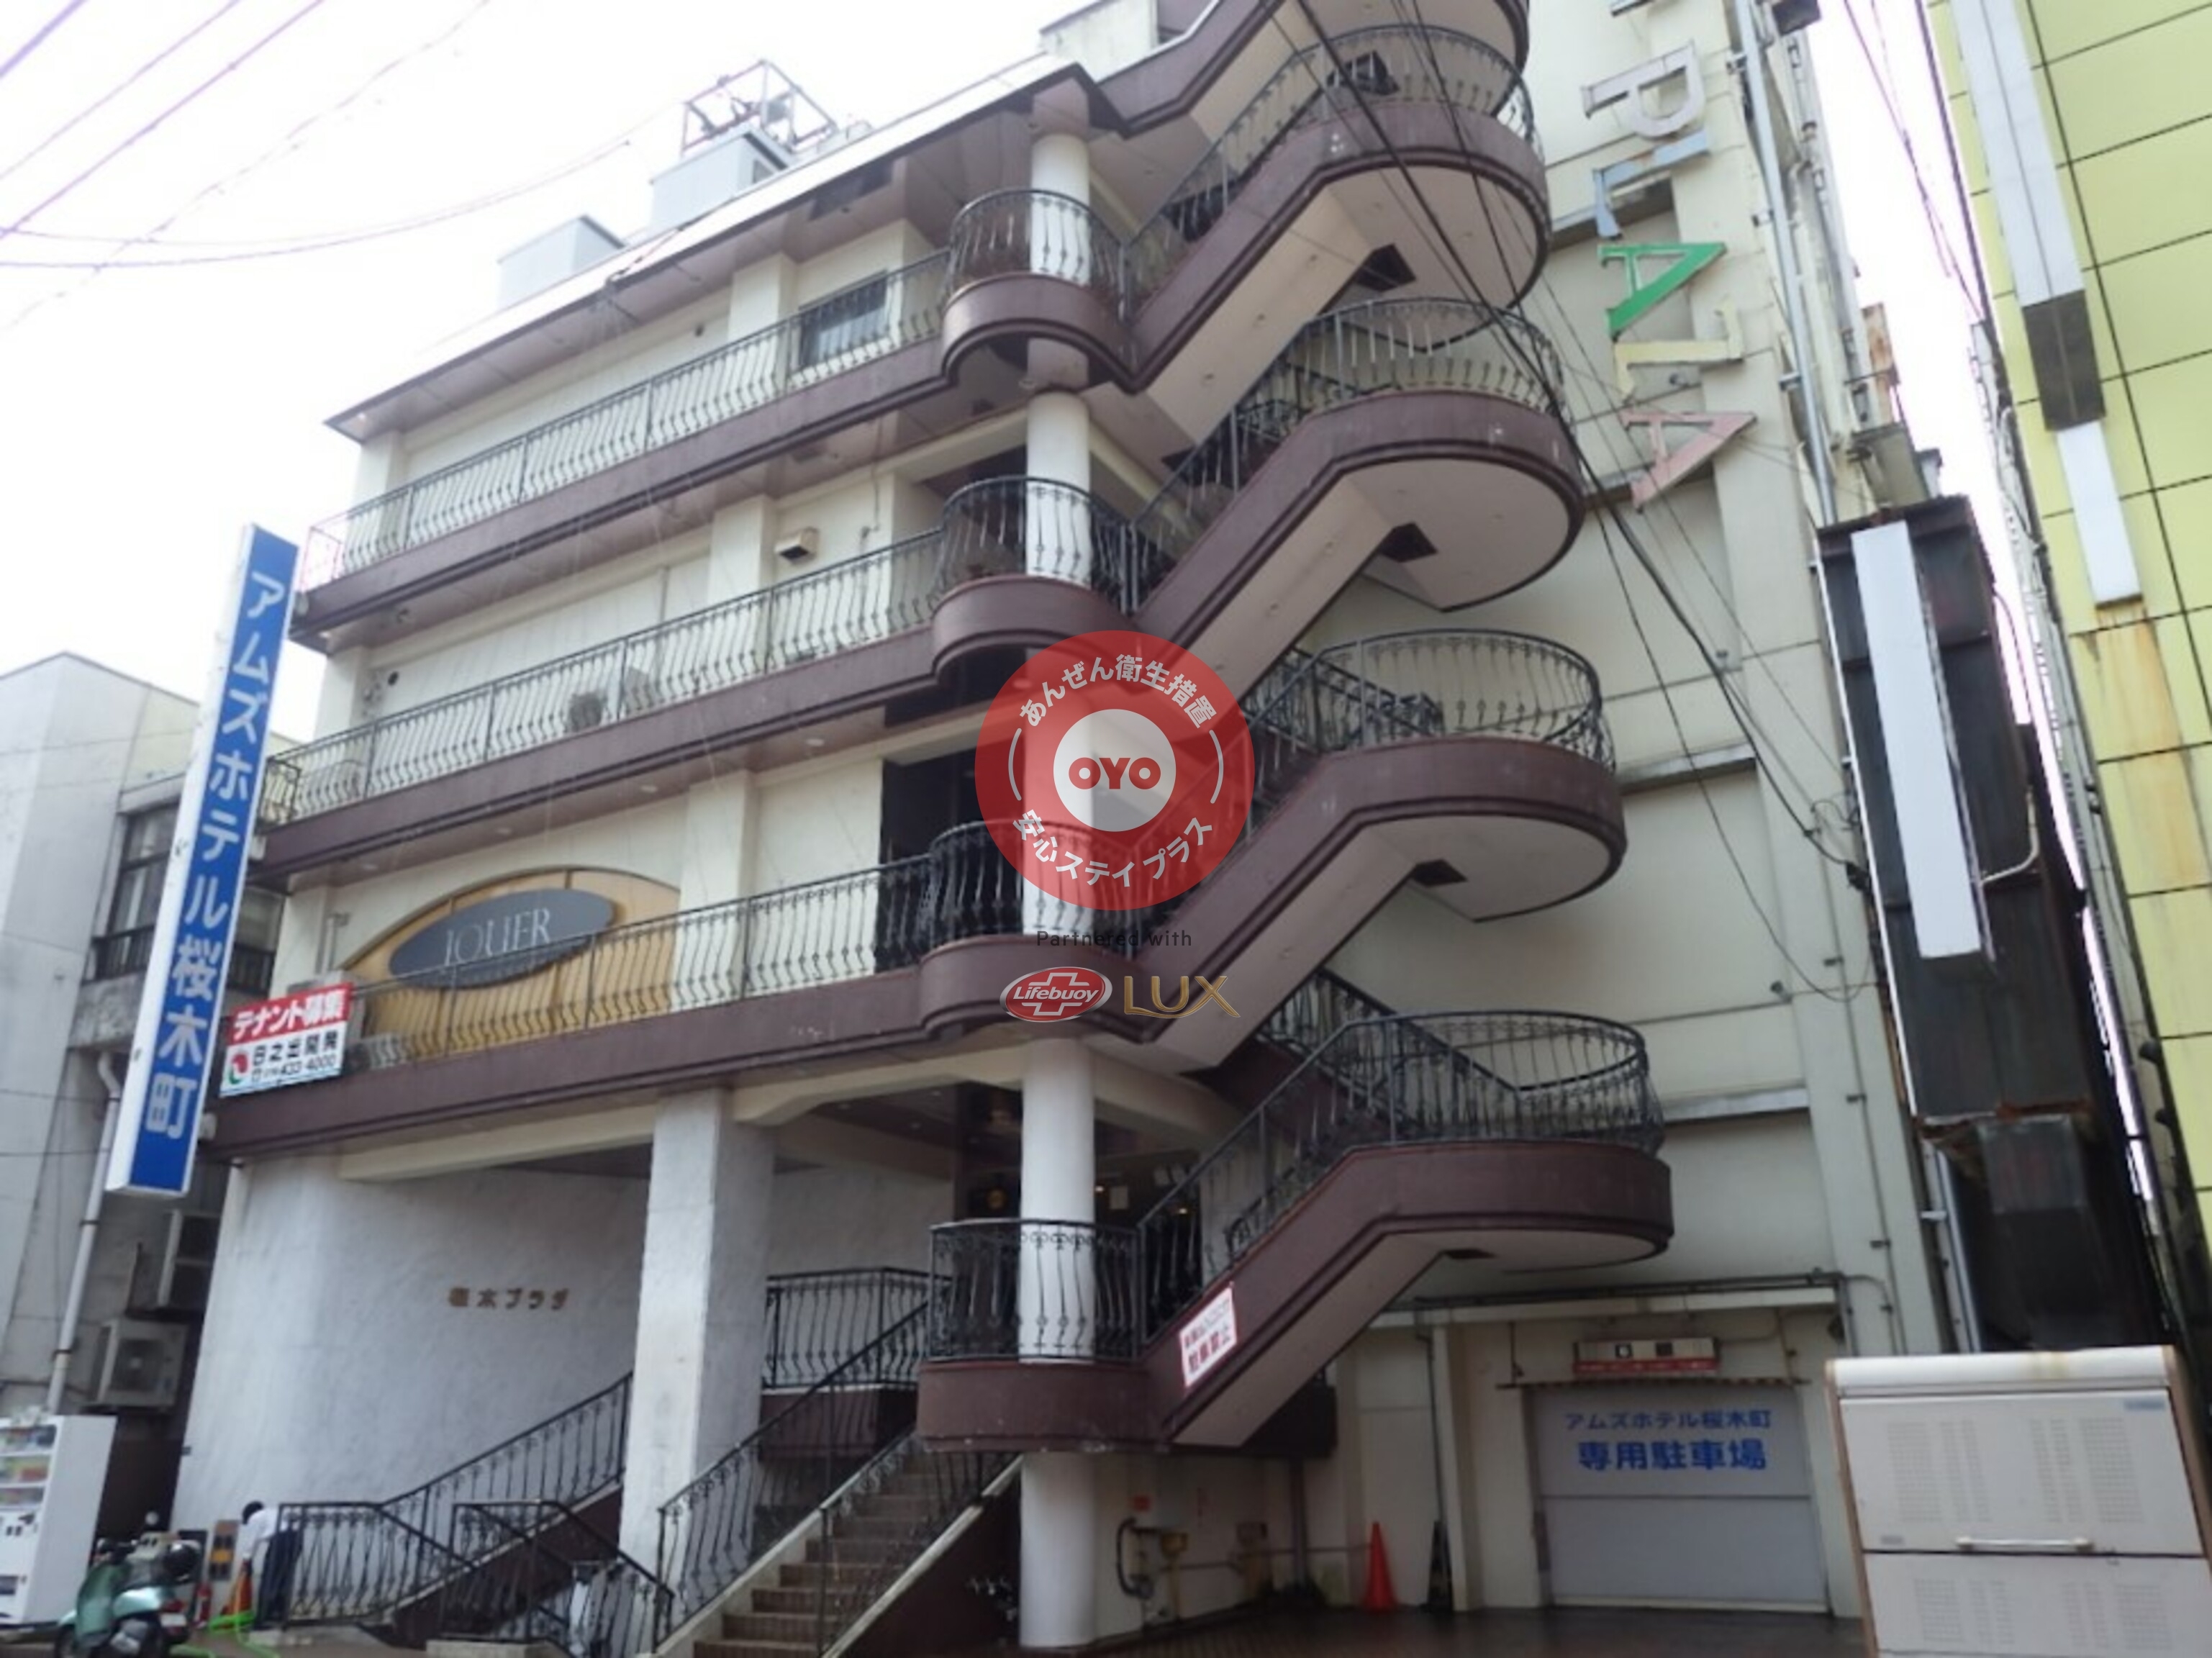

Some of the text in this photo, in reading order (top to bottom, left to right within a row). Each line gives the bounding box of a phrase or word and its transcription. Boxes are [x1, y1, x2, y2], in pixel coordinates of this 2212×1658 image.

[1581, 39, 1758, 513] PLAZA
[145, 571, 286, 1140] アムズホテル桜木町
[233, 988, 347, 1041] テナント募集
[1564, 1409, 1772, 1431] アムズホテル桜木町
[1578, 1437, 1767, 1471] 専用駐車場
